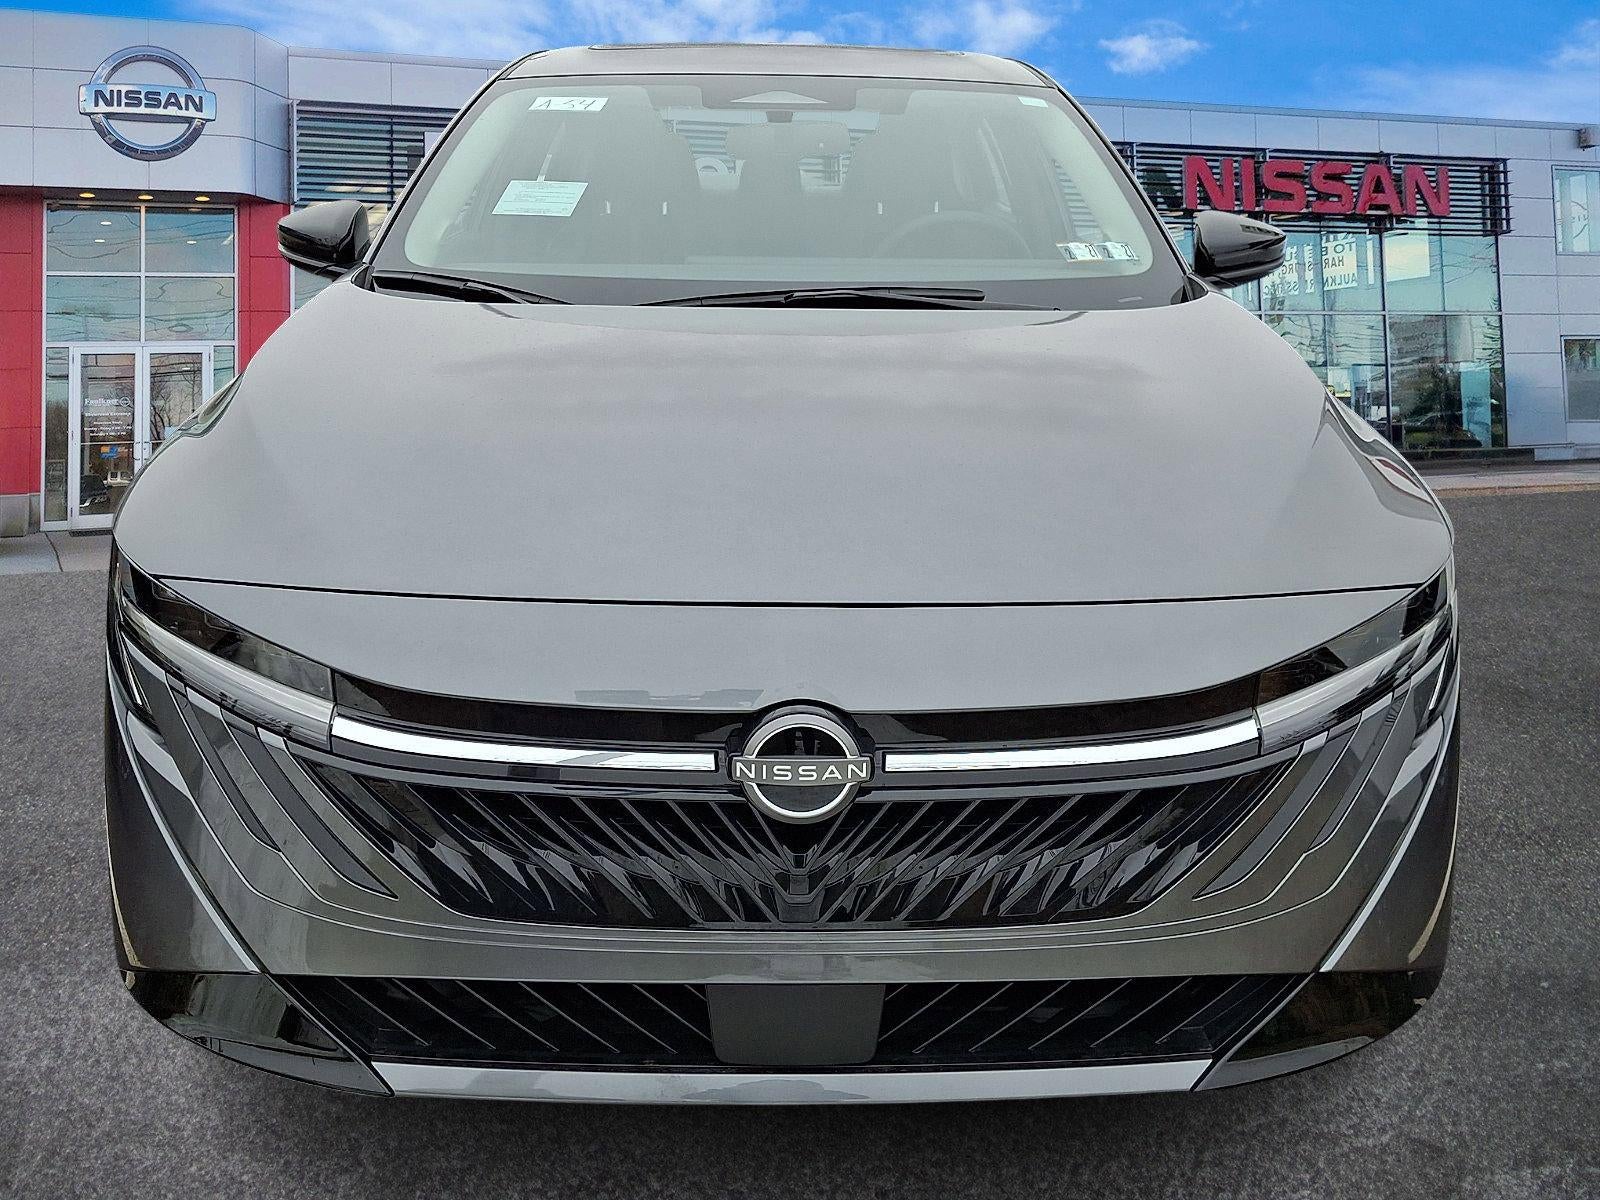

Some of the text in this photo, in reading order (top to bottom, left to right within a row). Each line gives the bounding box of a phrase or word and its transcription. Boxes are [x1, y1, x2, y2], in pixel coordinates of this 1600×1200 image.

[94, 89, 203, 113] NISSAN
[1182, 155, 1451, 218] NISSAN
[736, 762, 867, 781] NISSAN
